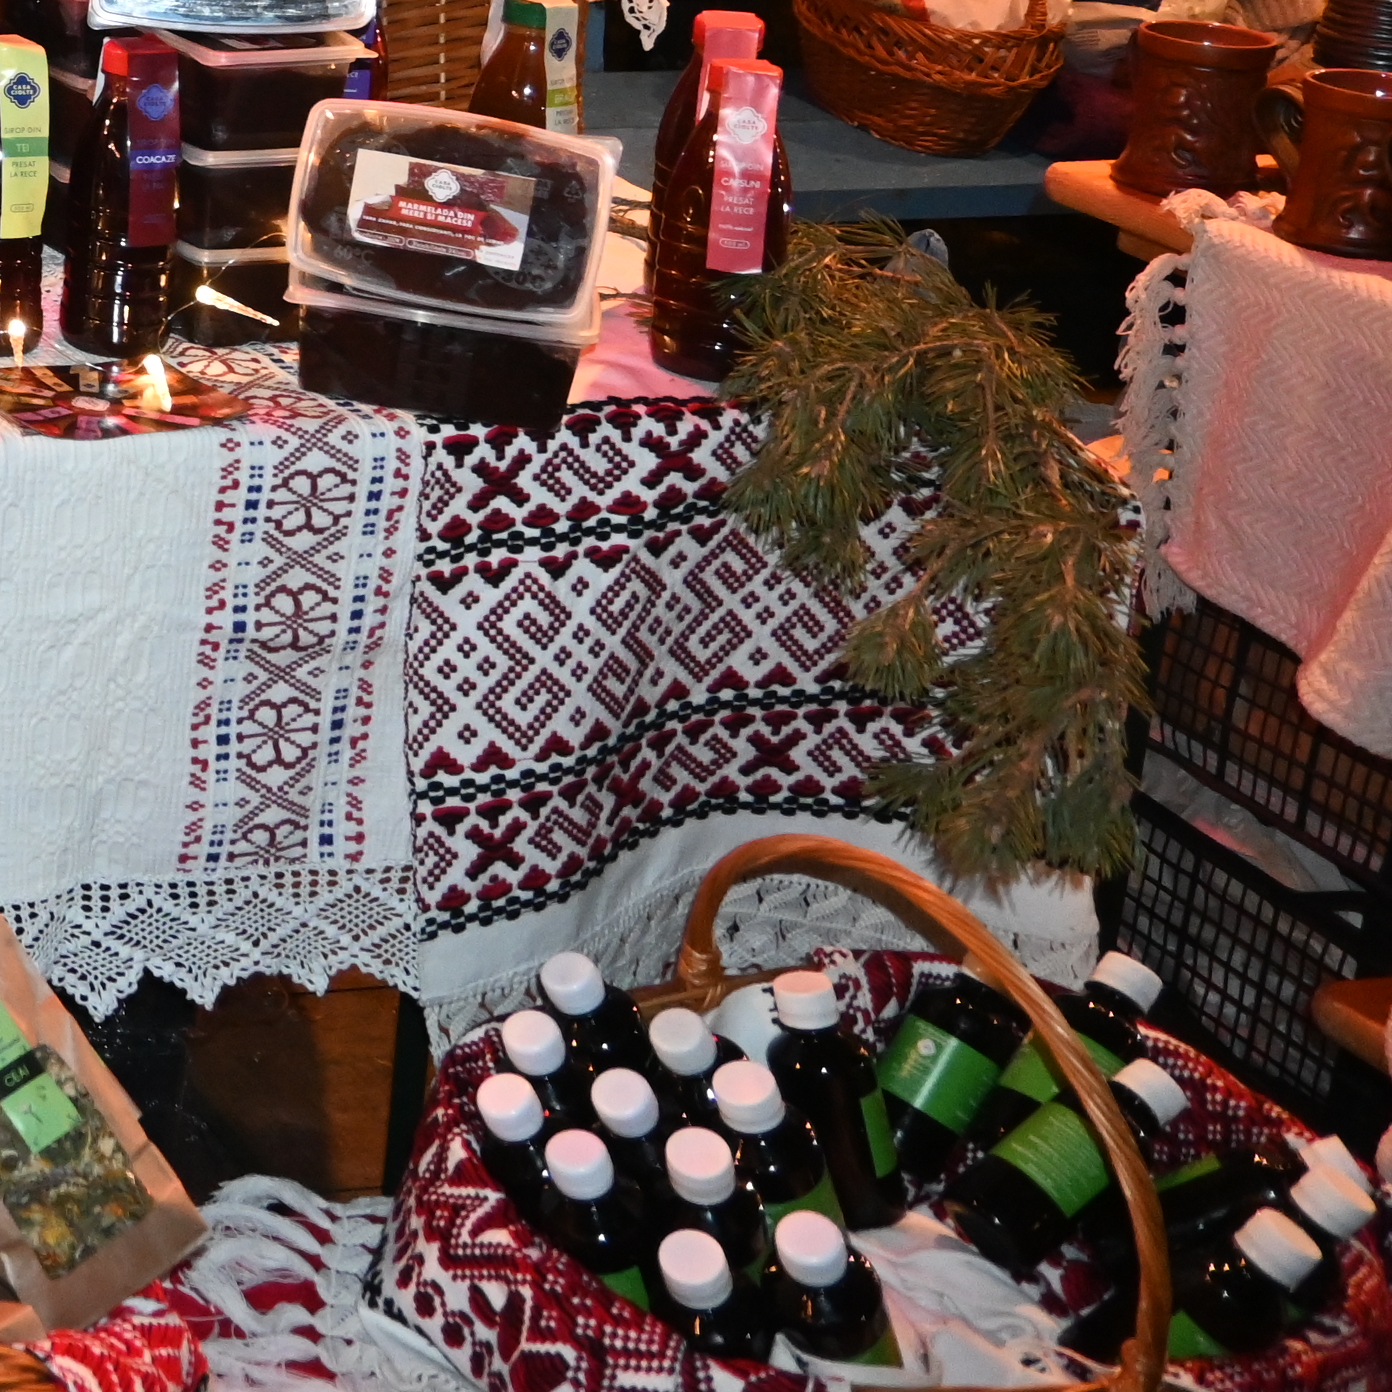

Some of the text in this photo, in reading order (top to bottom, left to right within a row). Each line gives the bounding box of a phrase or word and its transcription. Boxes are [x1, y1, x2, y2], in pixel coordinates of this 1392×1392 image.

[16, 143, 30, 152] TEI
[136, 155, 176, 164] COACAZE
[721, 178, 761, 189] CAPSUNI
[724, 197, 753, 205] PRESAT
[398, 201, 475, 220] MARMELADA DIN
[733, 207, 754, 215] RECE
[401, 209, 424, 218] MERE
[437, 215, 472, 227] MACESE
[4, 1064, 30, 1087] CEAI
